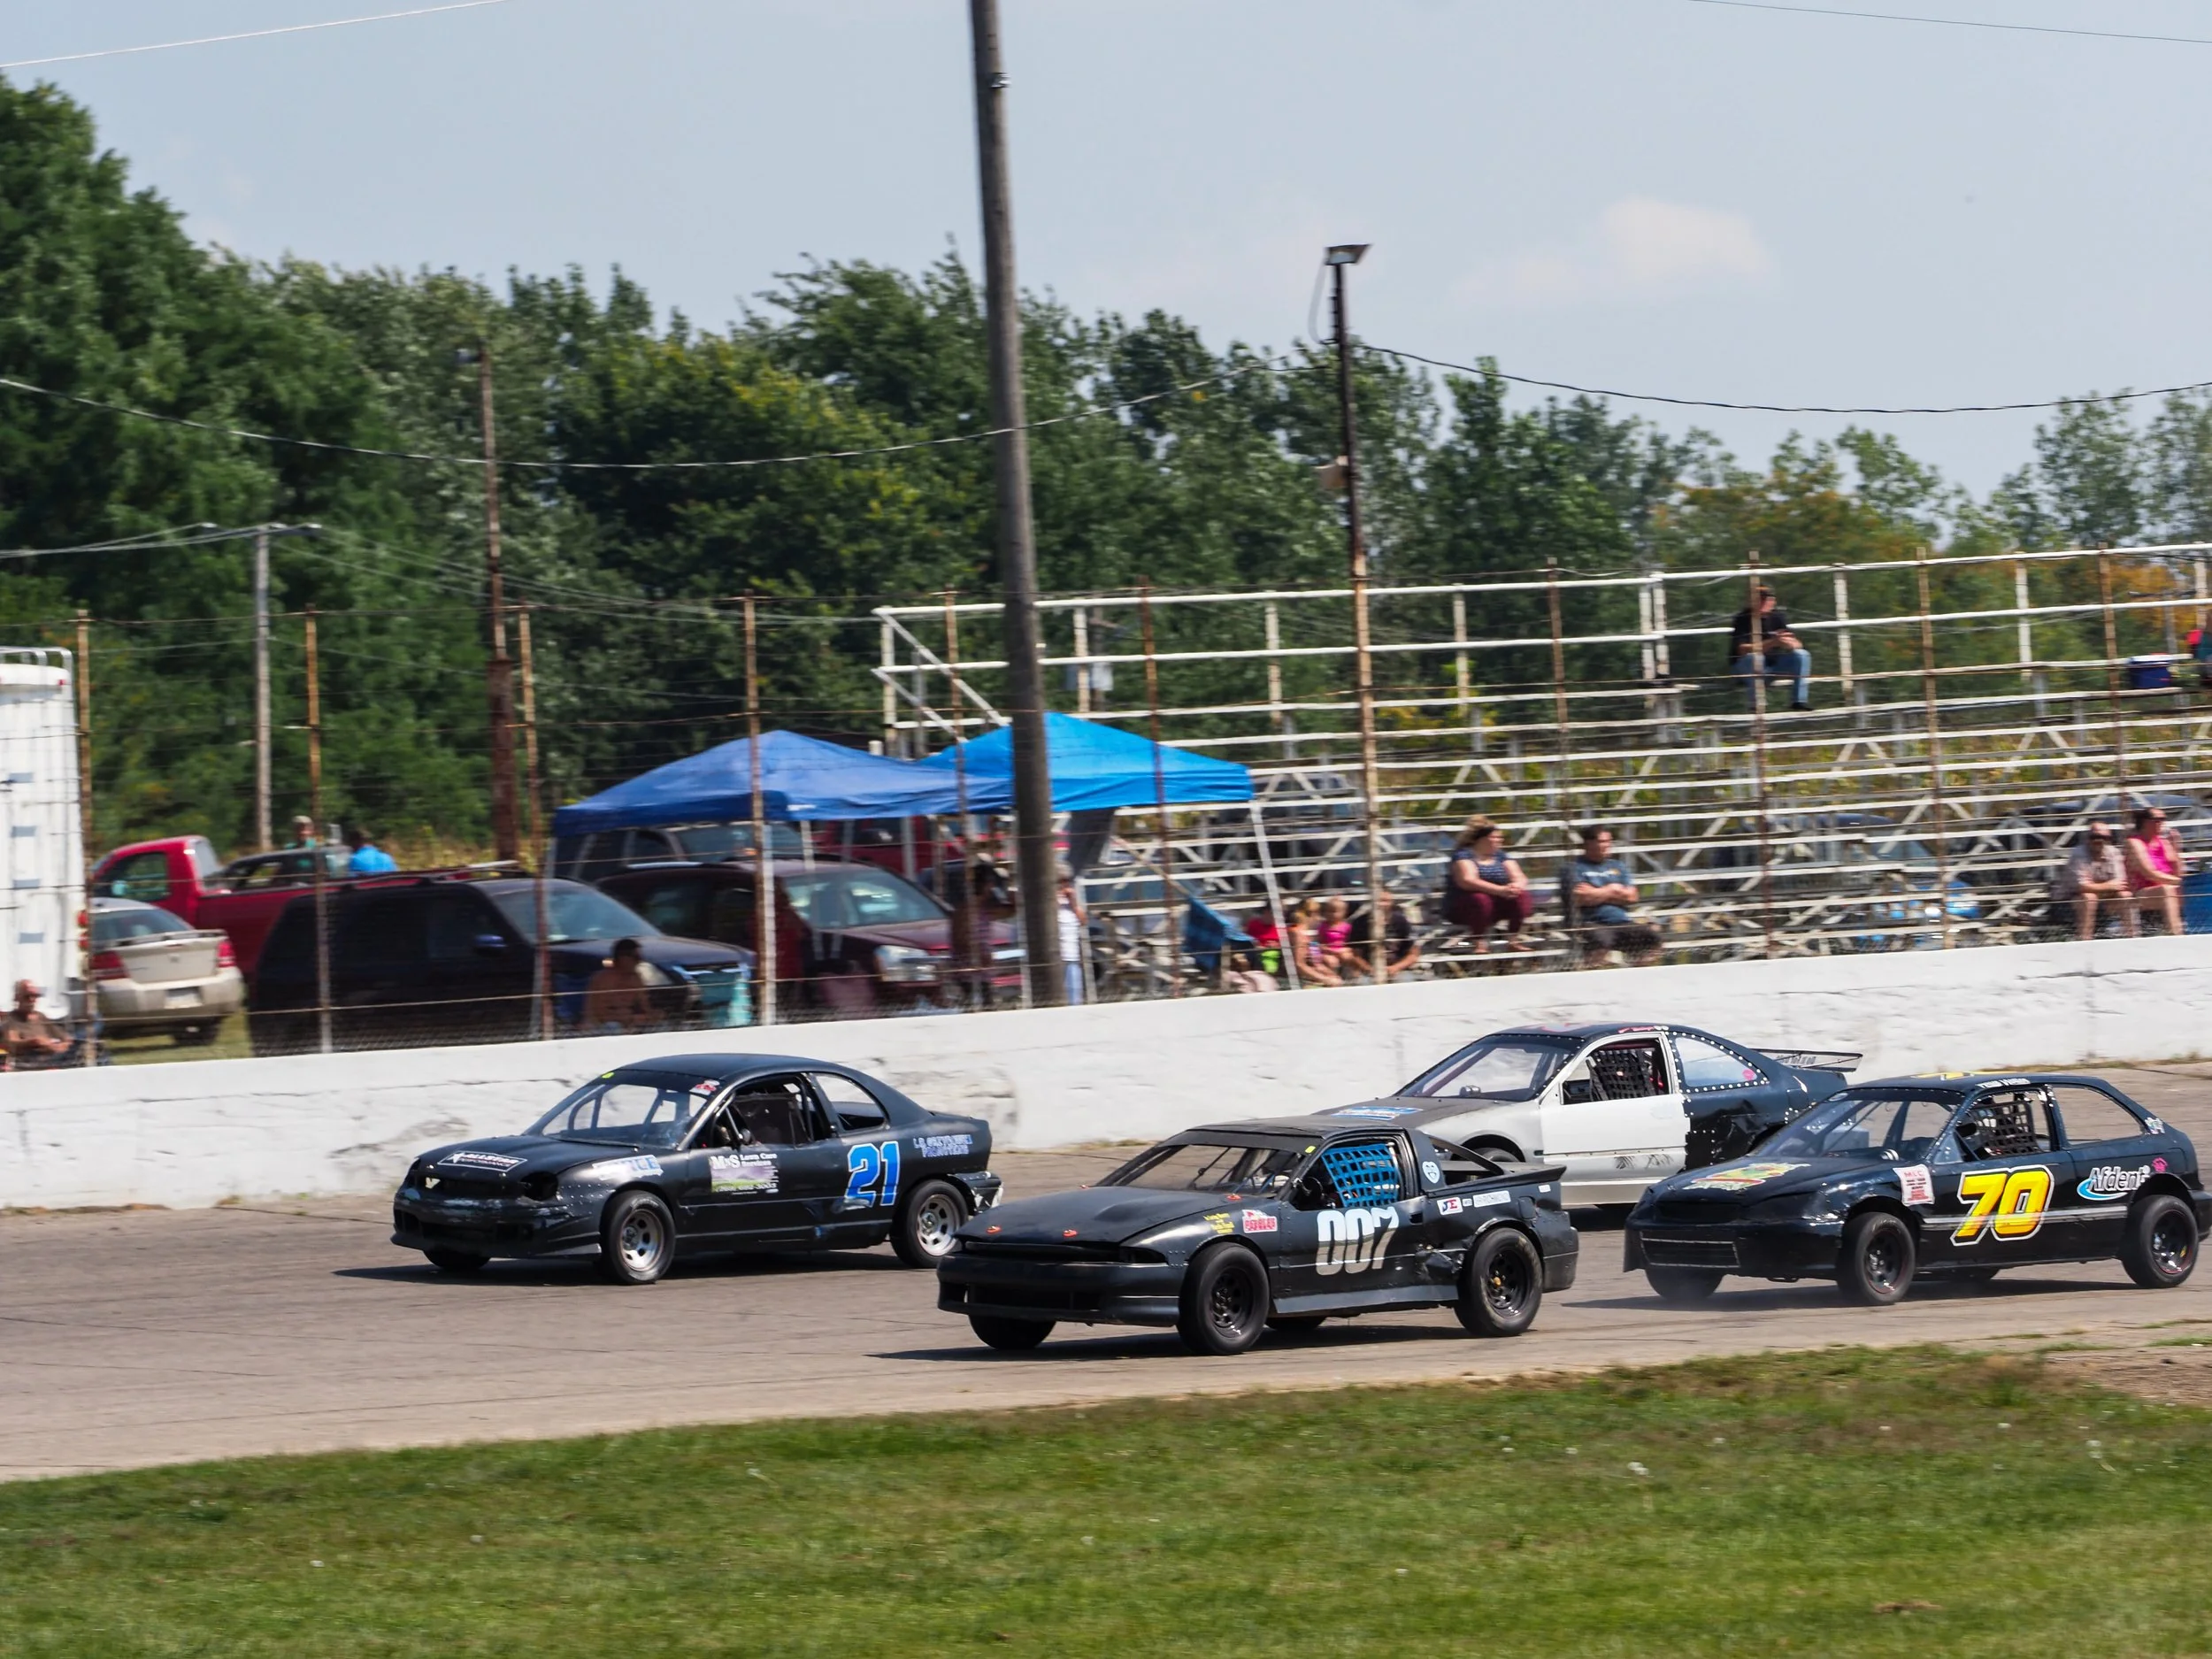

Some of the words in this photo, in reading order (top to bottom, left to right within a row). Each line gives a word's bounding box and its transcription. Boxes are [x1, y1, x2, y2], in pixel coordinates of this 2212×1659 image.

[844, 1141, 901, 1208] 21
[1950, 1164, 2055, 1247] 70
[1316, 1206, 1399, 1275] 007
